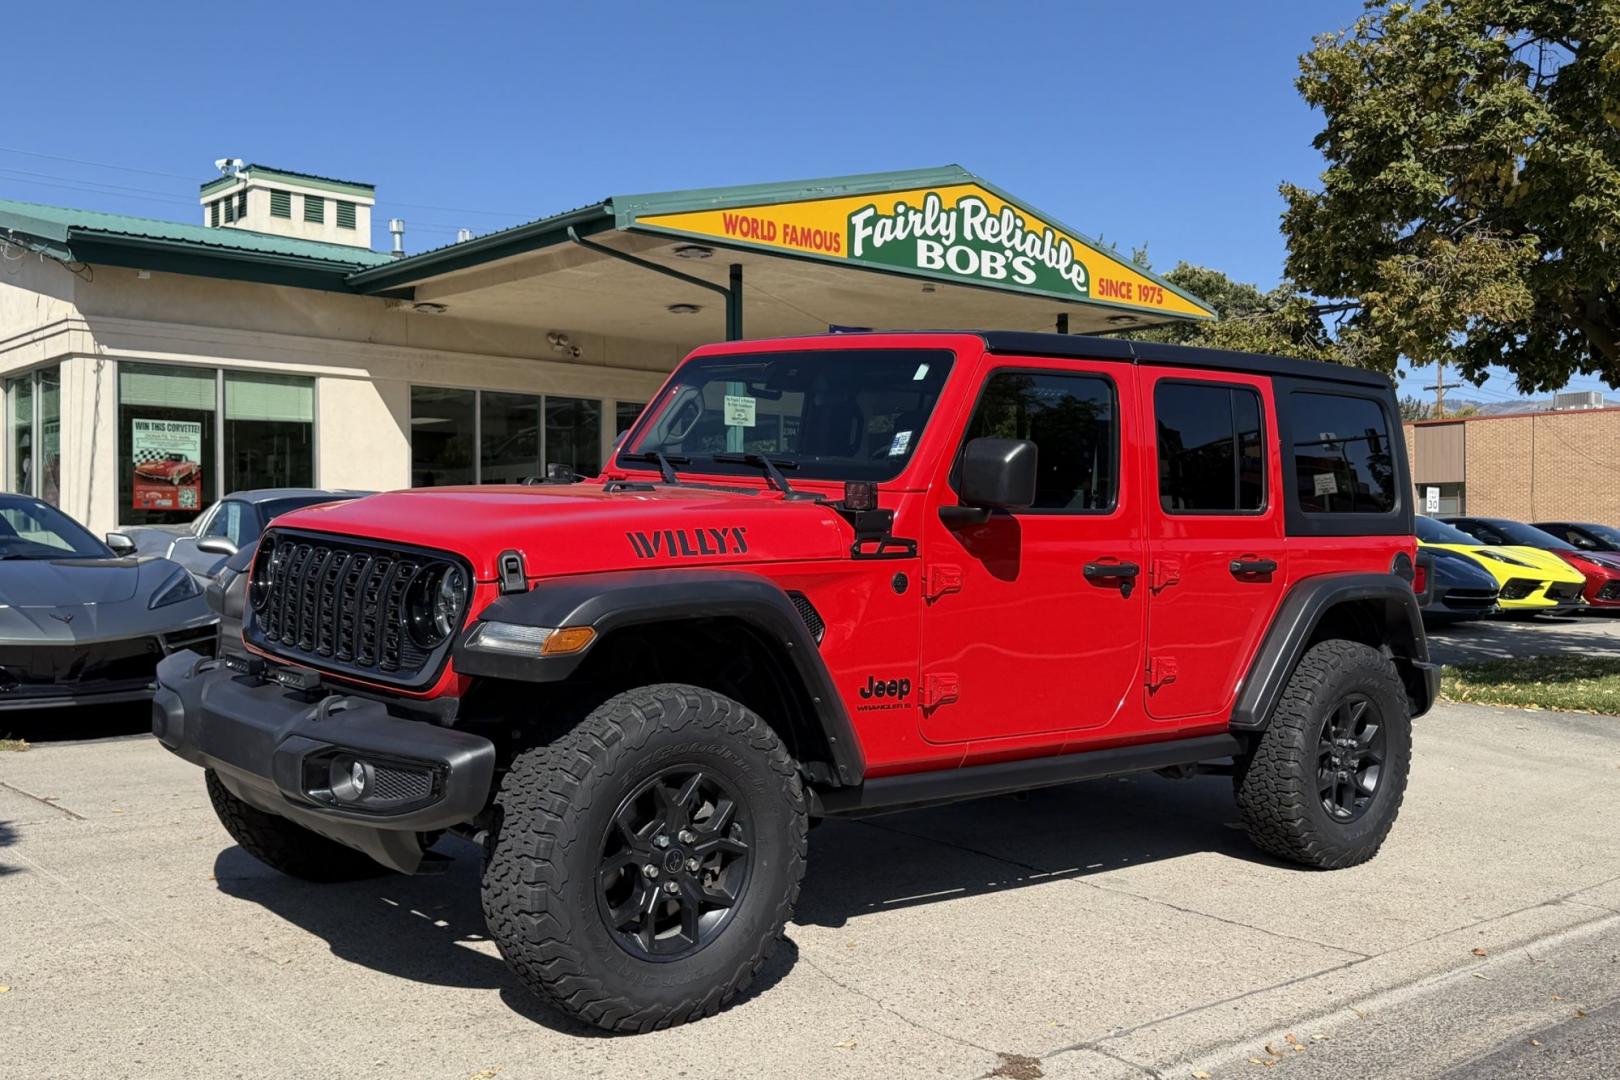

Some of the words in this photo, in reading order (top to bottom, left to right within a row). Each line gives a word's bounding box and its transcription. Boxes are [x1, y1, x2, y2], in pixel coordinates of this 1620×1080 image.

[723, 212, 777, 242] WORLD
[782, 223, 841, 253] FAMOUS
[851, 195, 957, 257] Fairly
[959, 198, 1087, 292] Reliable
[917, 238, 1037, 285] BOB'S
[1098, 277, 1133, 300] SINCE
[1137, 284, 1164, 305] 1975
[135, 421, 150, 431] WIN
[151, 422, 166, 432] THIS
[167, 423, 200, 434] CORVETTE!
[1427, 499, 1438, 510] 30
[624, 527, 748, 558] WILLYS
[859, 675, 911, 701] Jeep
